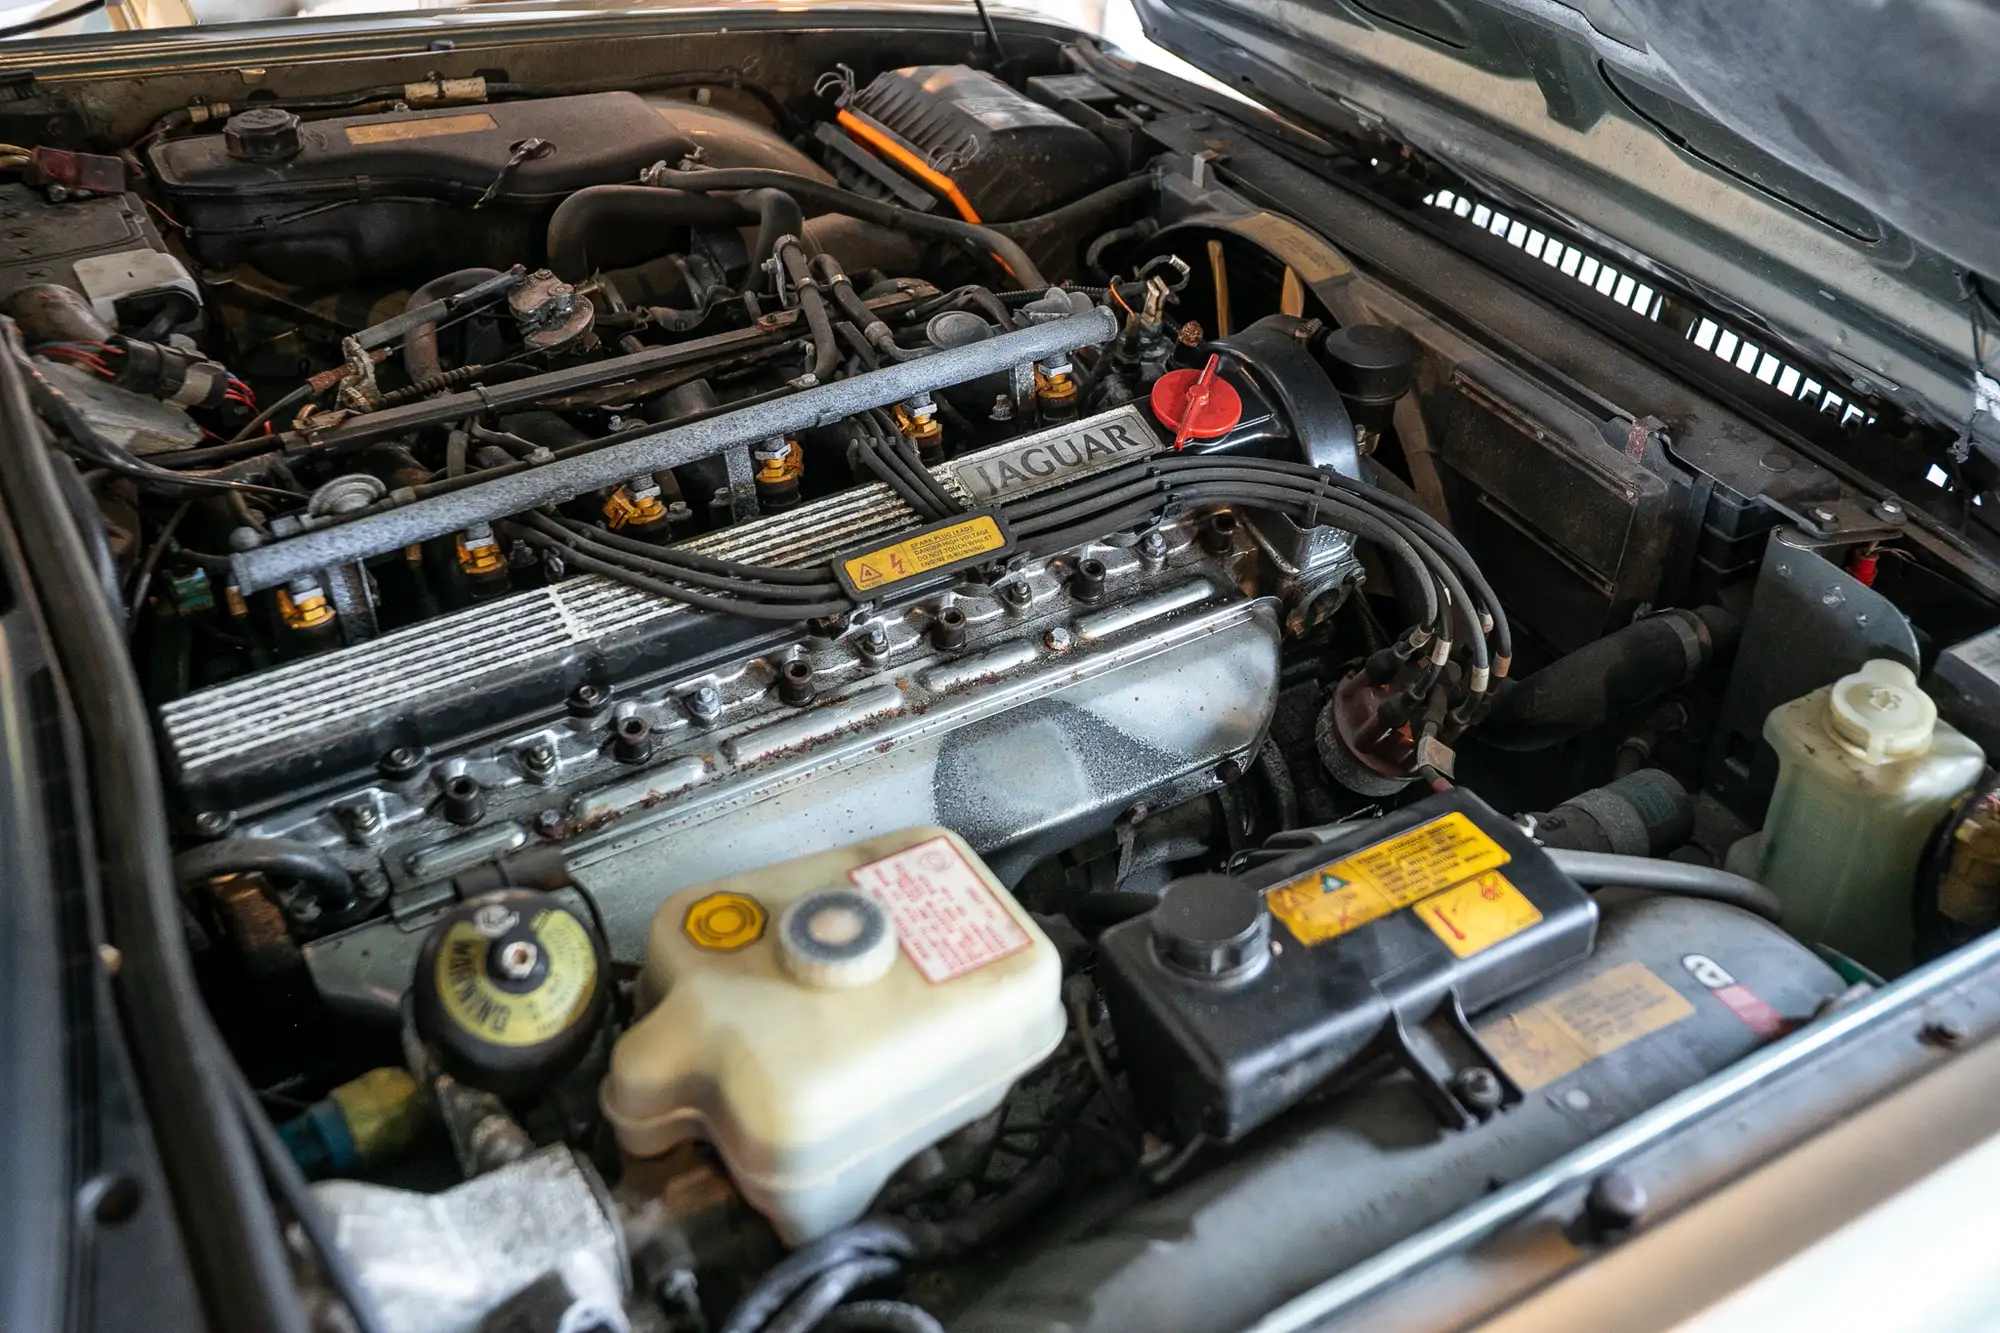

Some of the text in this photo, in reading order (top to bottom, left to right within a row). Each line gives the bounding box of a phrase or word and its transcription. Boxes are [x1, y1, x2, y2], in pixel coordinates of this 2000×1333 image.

[975, 424, 1140, 496] JAGUAR
[910, 525, 974, 549] SPARK PLUG LEADS
[913, 528, 989, 556] DANGER HIGH VOLTAGE
[917, 534, 993, 561] DO NOT TOUCH WHILST
[920, 556, 945, 568] ENGINE
[953, 544, 985, 557] RUNNING
